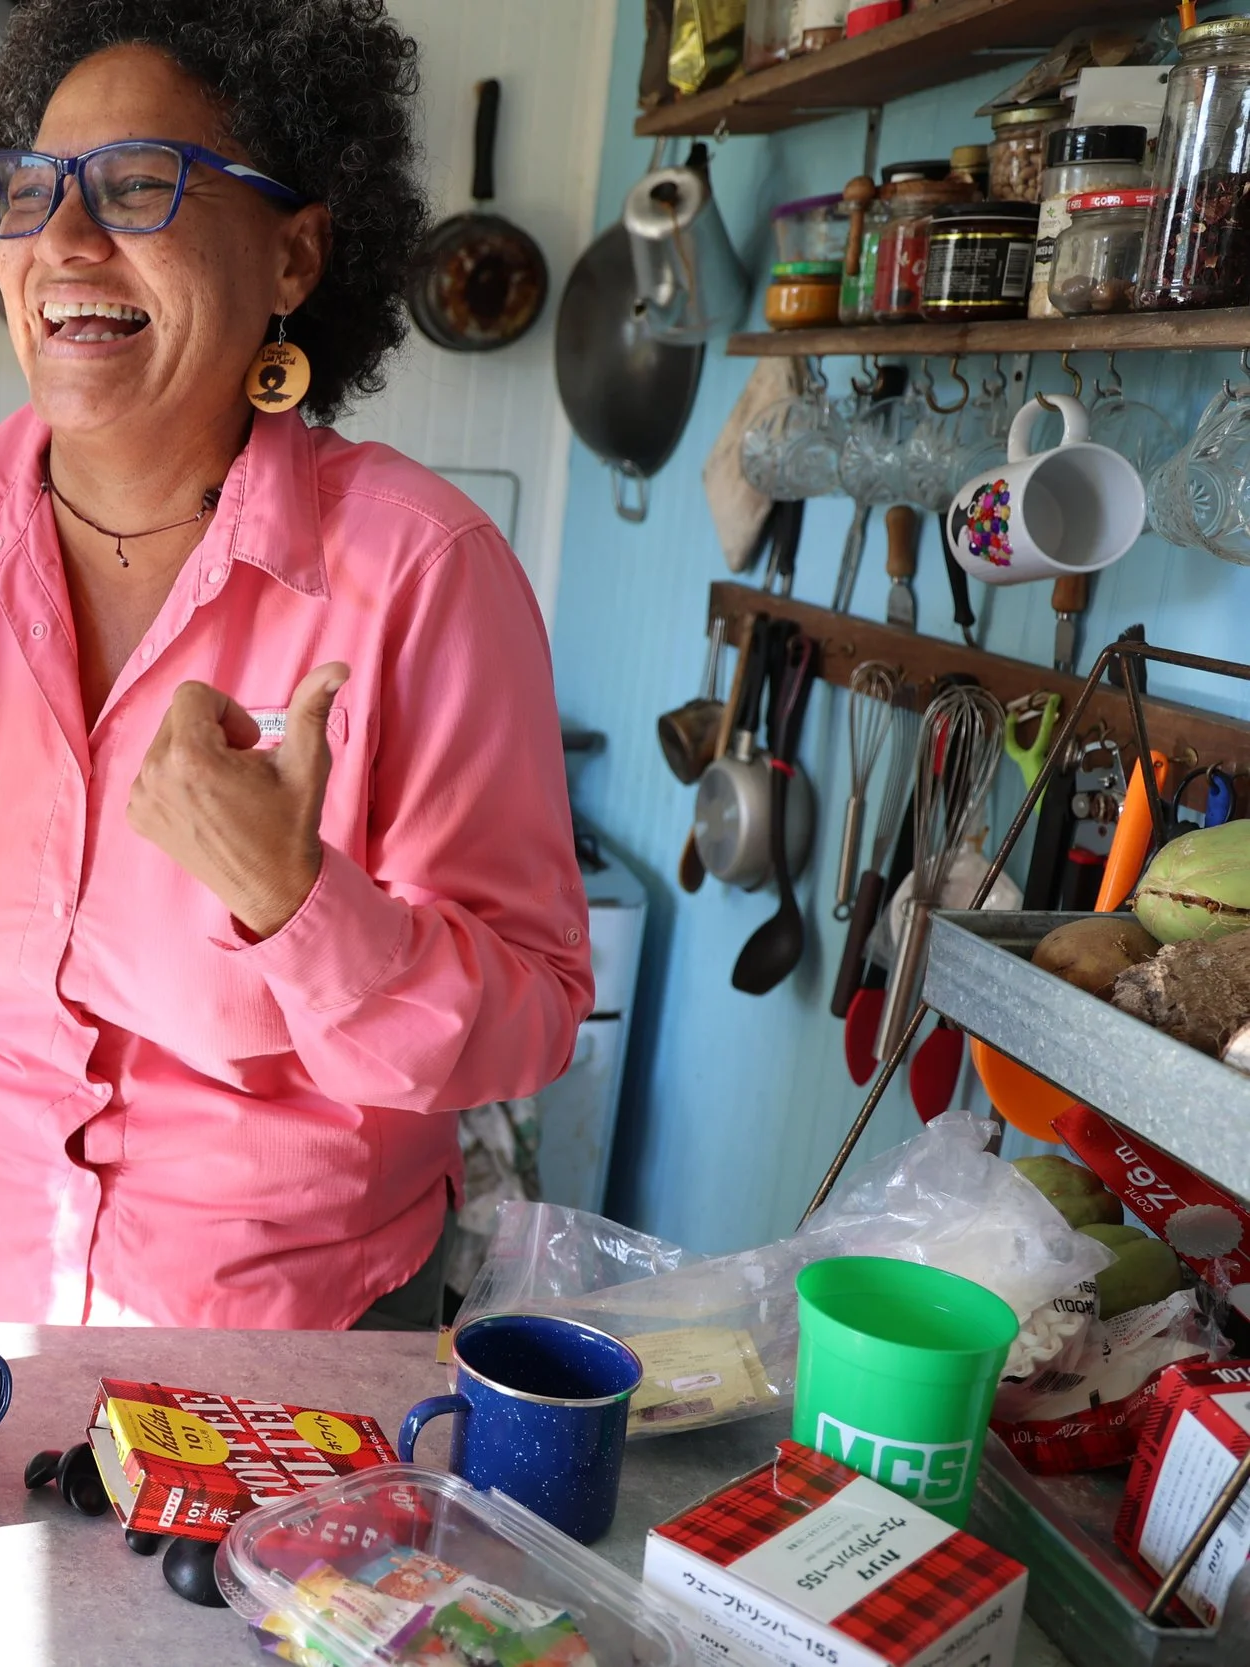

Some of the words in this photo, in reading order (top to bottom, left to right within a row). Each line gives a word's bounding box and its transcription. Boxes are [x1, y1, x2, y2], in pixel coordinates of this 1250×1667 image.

[1115, 1145, 1139, 1164] m
[1124, 1185, 1154, 1213] cont.
[1127, 1167, 1177, 1210] 7,6
[137, 1408, 182, 1457] Kalita
[181, 1425, 204, 1450] 101
[313, 1415, 343, 1452] ホワイト
[1013, 1430, 1033, 1444] 101
[818, 1415, 970, 1502] MCS
[185, 1501, 204, 1524] 101
[857, 1549, 902, 1581] カリタ
